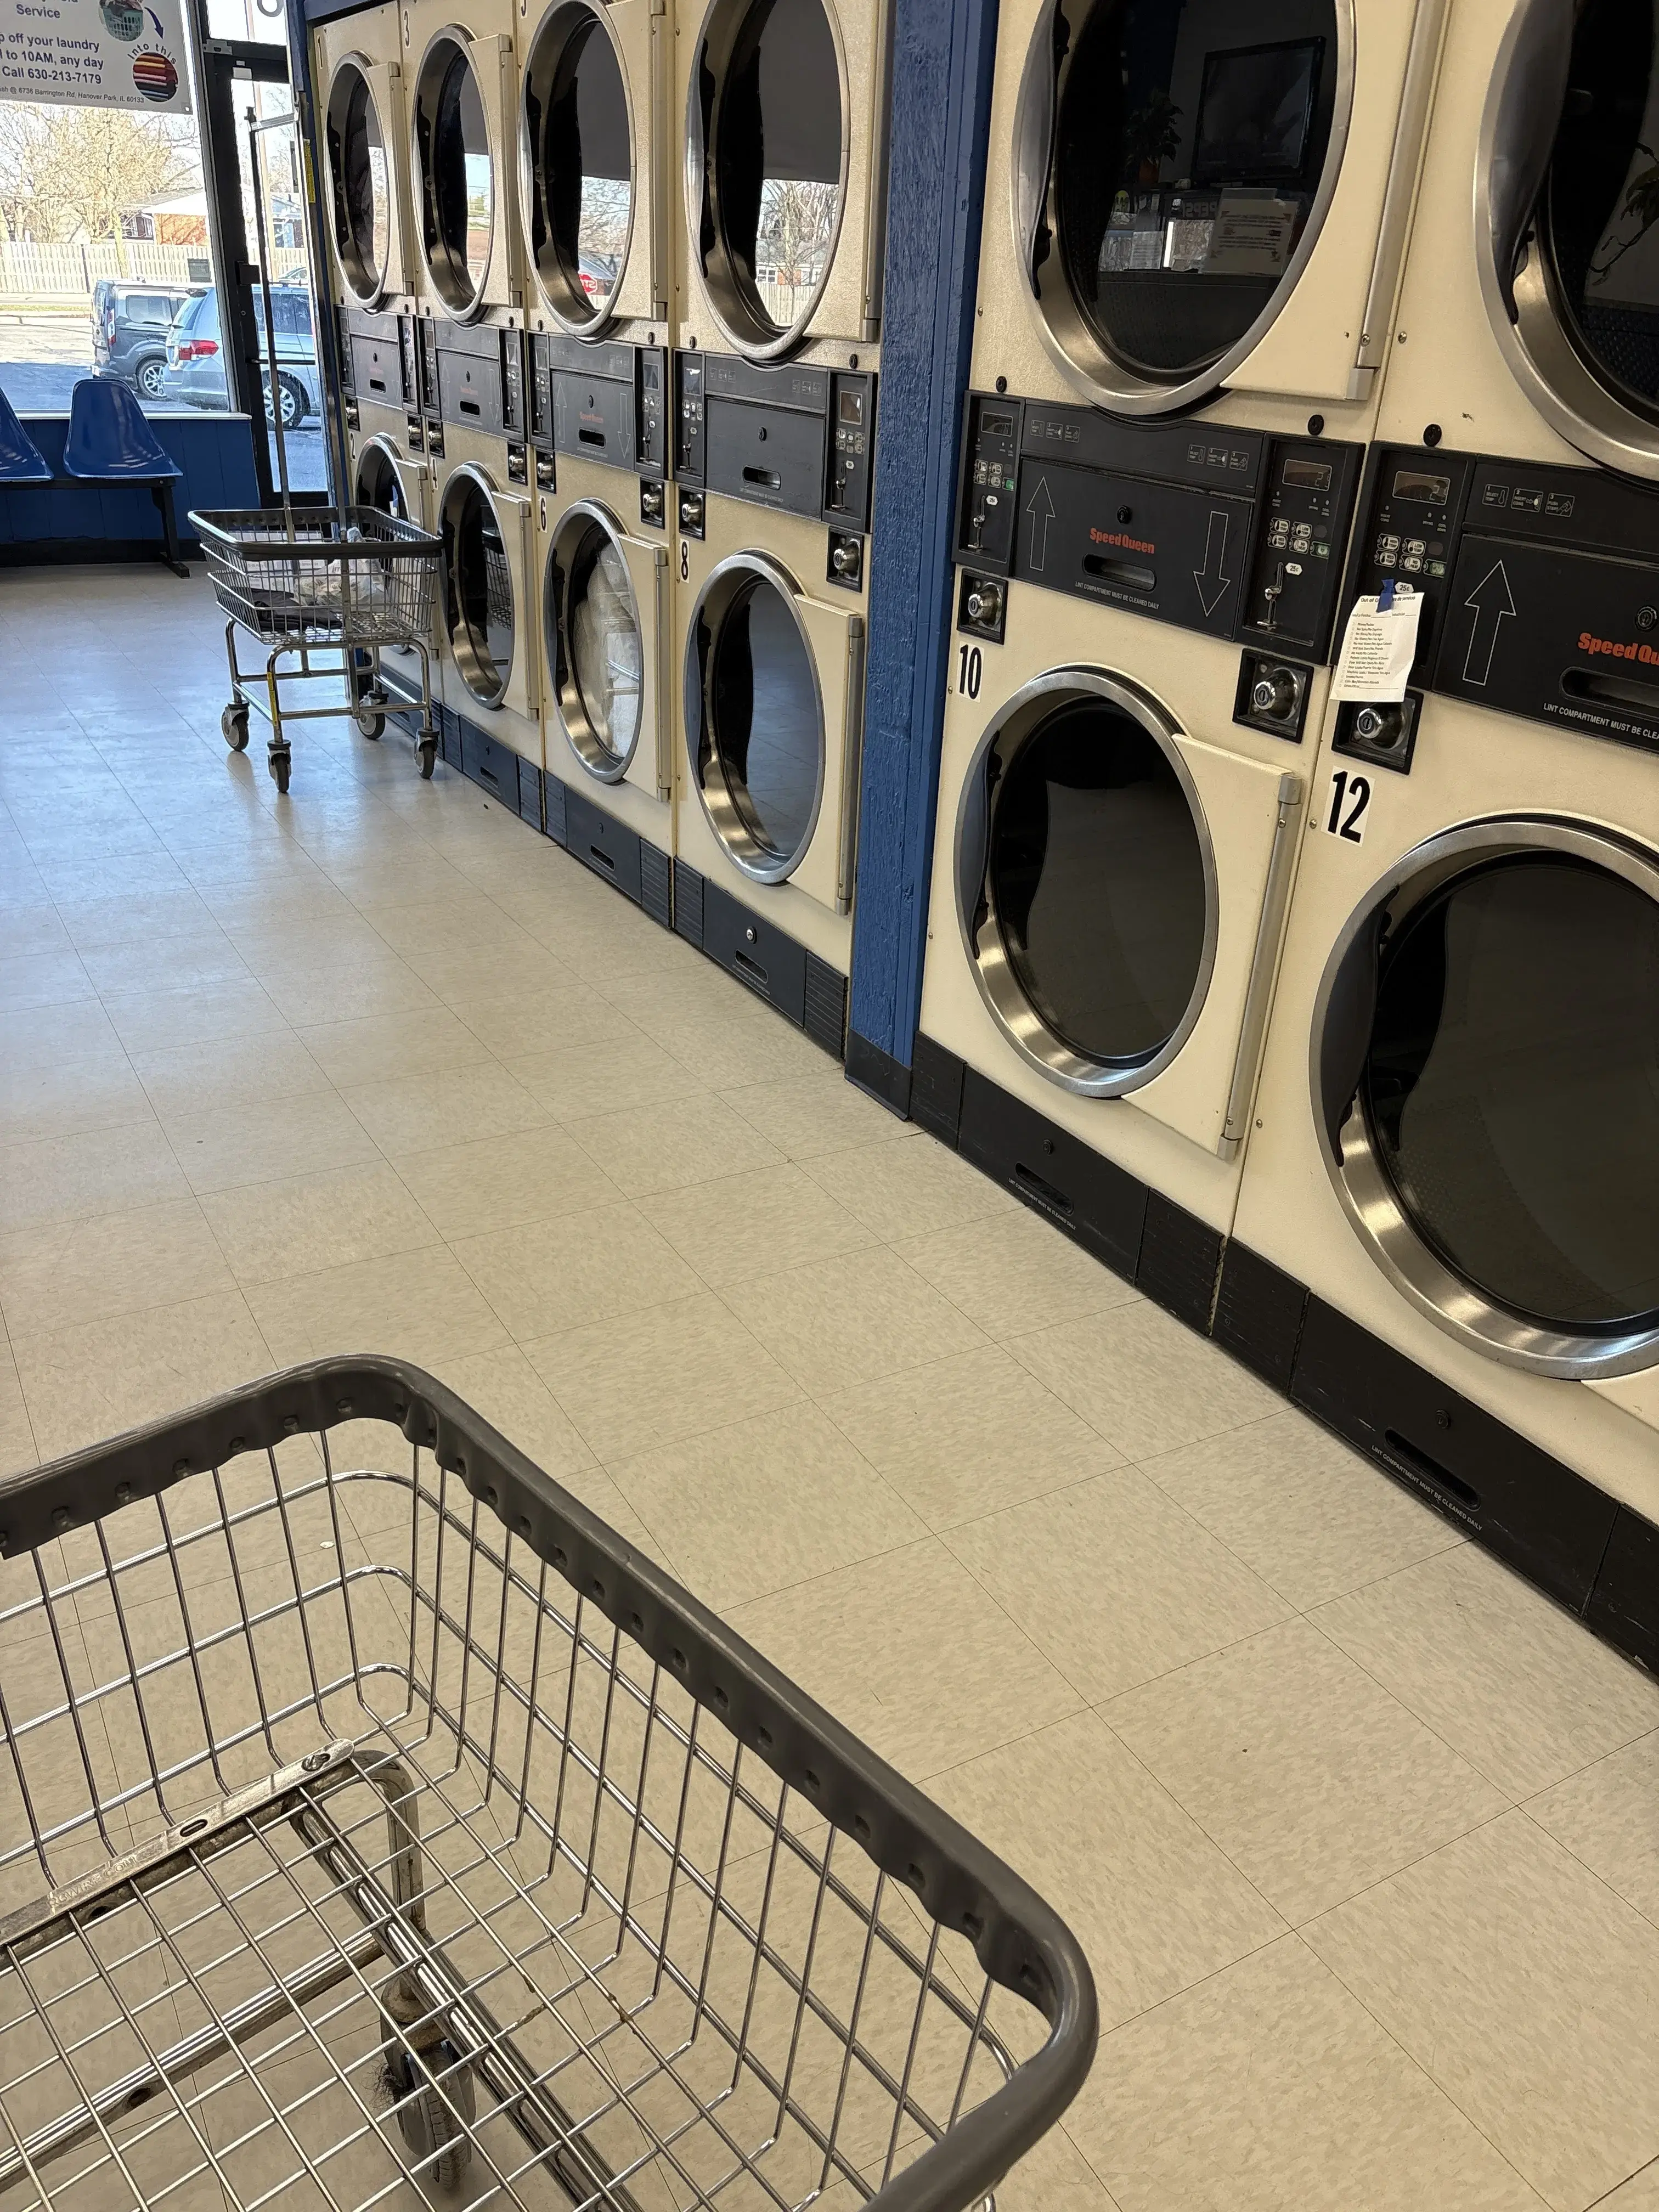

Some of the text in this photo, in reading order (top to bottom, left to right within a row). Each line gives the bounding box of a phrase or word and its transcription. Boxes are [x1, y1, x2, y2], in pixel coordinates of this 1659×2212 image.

[16, 4, 60, 19] Service
[8, 33, 24, 44] off
[27, 36, 53, 47] your
[57, 37, 99, 53] laundry
[404, 10, 409, 47] 3
[6, 50, 18, 60] to
[21, 50, 57, 66] 10AM,
[60, 56, 80, 68] any
[83, 56, 103, 70] day
[127, 43, 176, 65] Into this
[2, 66, 101, 84] Call 630-213-7179
[35, 88, 65, 97] Barrington
[432, 459, 437, 488] 4
[540, 498, 546, 531] 6
[681, 541, 689, 580] 8
[1075, 581, 1084, 589] LINT
[1084, 584, 1111, 596] COMPARTMENT
[1111, 591, 1123, 599] MUST
[1129, 596, 1148, 606] CLEANED
[1148, 601, 1160, 610] DAILY
[1578, 633, 1638, 660] Speed
[960, 644, 982, 699] 10
[1543, 702, 1559, 713] LINT
[1559, 707, 1610, 727] COMPARTMENT
[1611, 720, 1630, 732] MUST
[1631, 726, 1642, 735] BE
[1328, 771, 1370, 843] 12
[1372, 1444, 1482, 1531] LINT COMPARTMENT MUST BE CLEANED DAILY
